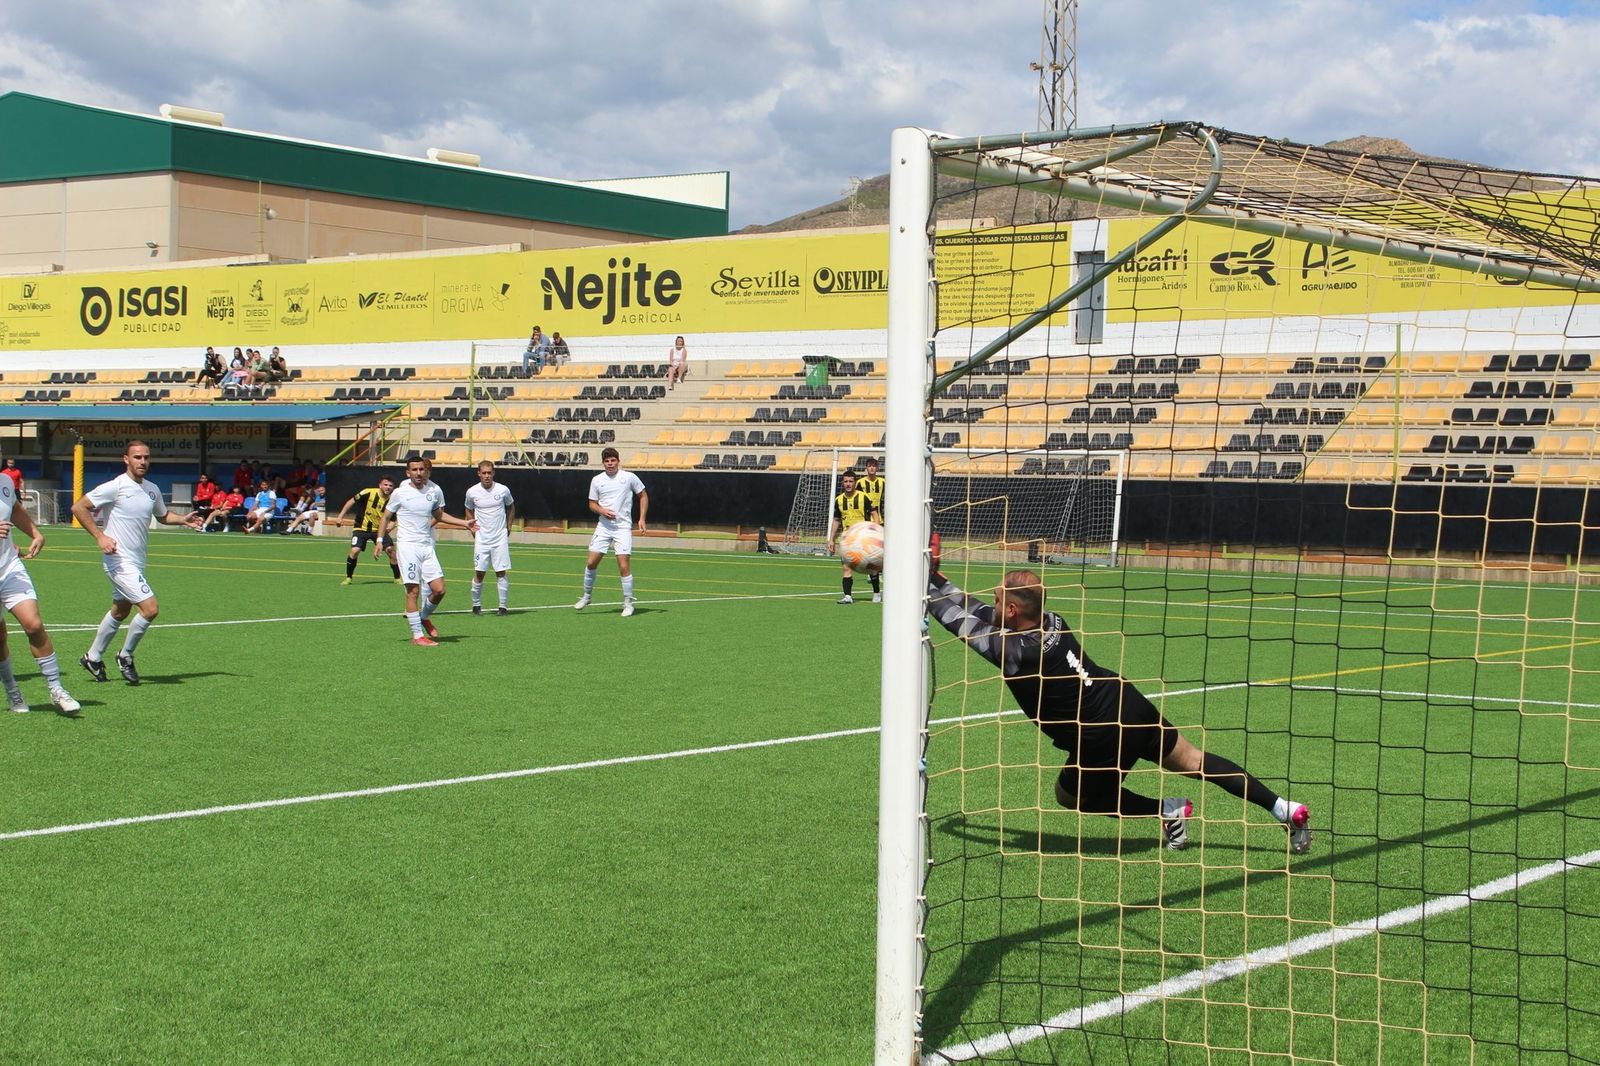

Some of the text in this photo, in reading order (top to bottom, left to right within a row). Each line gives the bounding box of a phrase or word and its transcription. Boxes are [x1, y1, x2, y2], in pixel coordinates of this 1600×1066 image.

[1117, 248, 1188, 273] ucafri
[711, 267, 800, 295] Sevilla
[1118, 275, 1165, 284] Hormigones
[393, 291, 430, 303] Plantel
[541, 257, 682, 325] Nejite
[754, 289, 800, 297] invernaderos
[8, 302, 52, 312] Diego Villegas
[212, 296, 234, 307] OVEJA
[441, 297, 485, 313] ORGIVA
[207, 304, 235, 321] Negra
[246, 309, 269, 317] DIEGO
[620, 312, 682, 324] AGRÍCOLA
[123, 322, 182, 333] PUBLICIDAD
[226, 422, 263, 439] Berja
[178, 438, 193, 449] de
[196, 439, 244, 451] Dportes
[408, 562, 417, 572] 21
